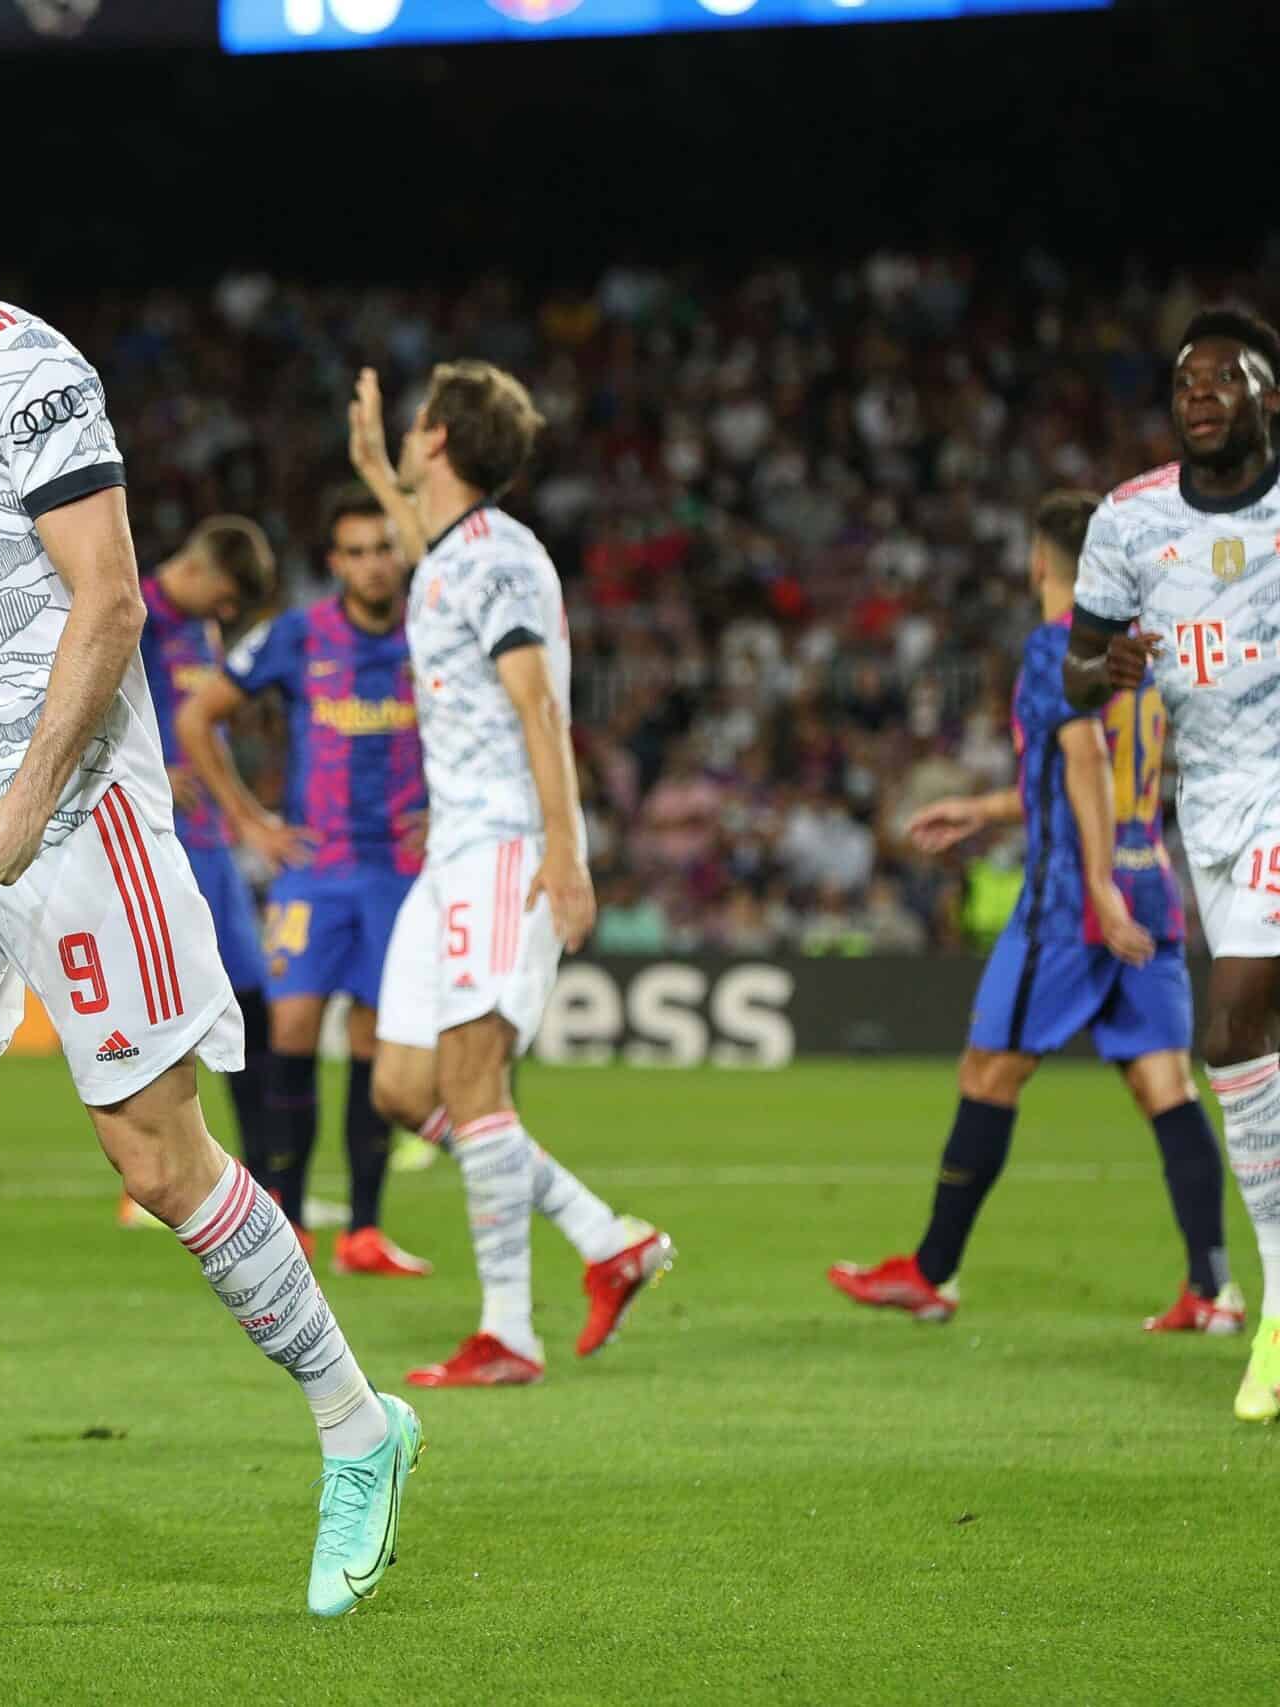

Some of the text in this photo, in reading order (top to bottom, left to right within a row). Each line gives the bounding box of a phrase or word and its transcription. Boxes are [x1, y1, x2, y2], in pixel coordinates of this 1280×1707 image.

[1176, 621, 1224, 685] T
[58, 932, 110, 1015] 9
[95, 1047, 140, 1062] adidas
